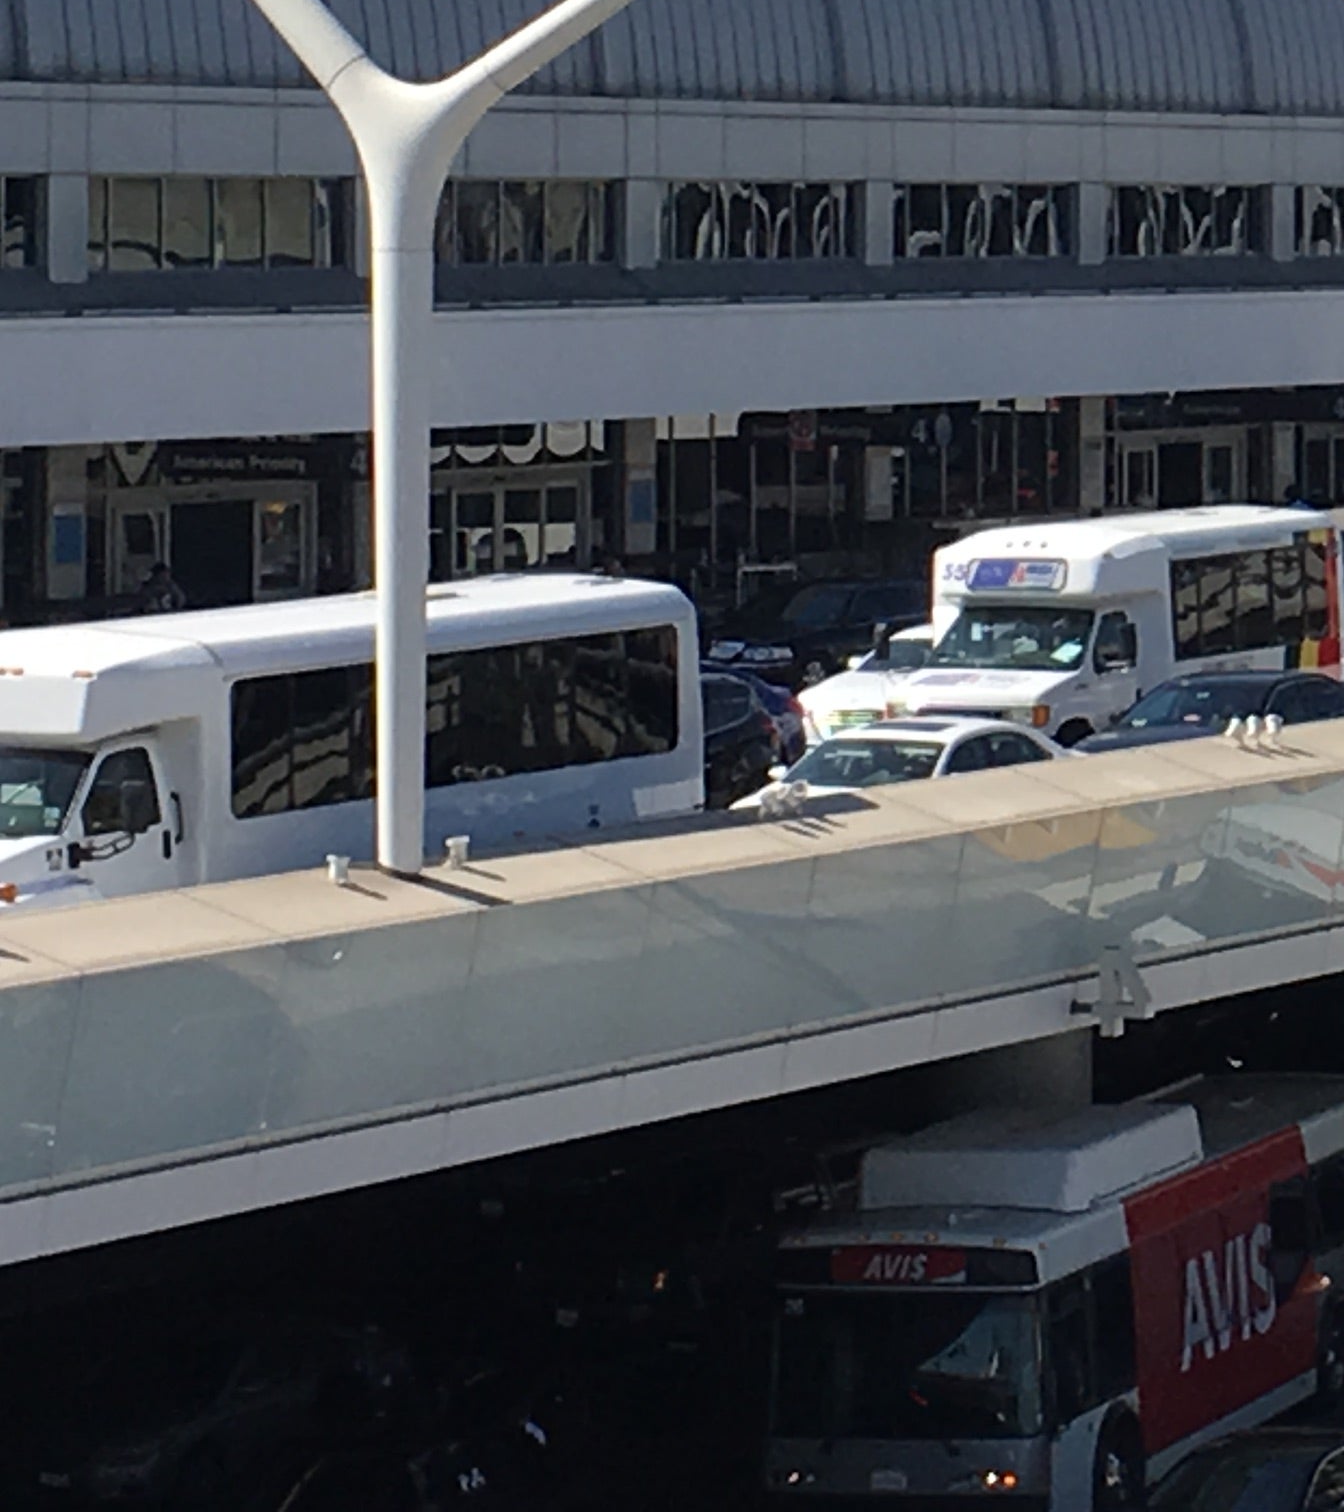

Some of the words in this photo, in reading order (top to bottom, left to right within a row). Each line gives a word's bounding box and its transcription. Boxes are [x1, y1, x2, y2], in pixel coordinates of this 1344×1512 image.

[911, 418, 927, 444] 4
[863, 1253, 928, 1281] AVIS
[1180, 1222, 1276, 1373] AVIS
